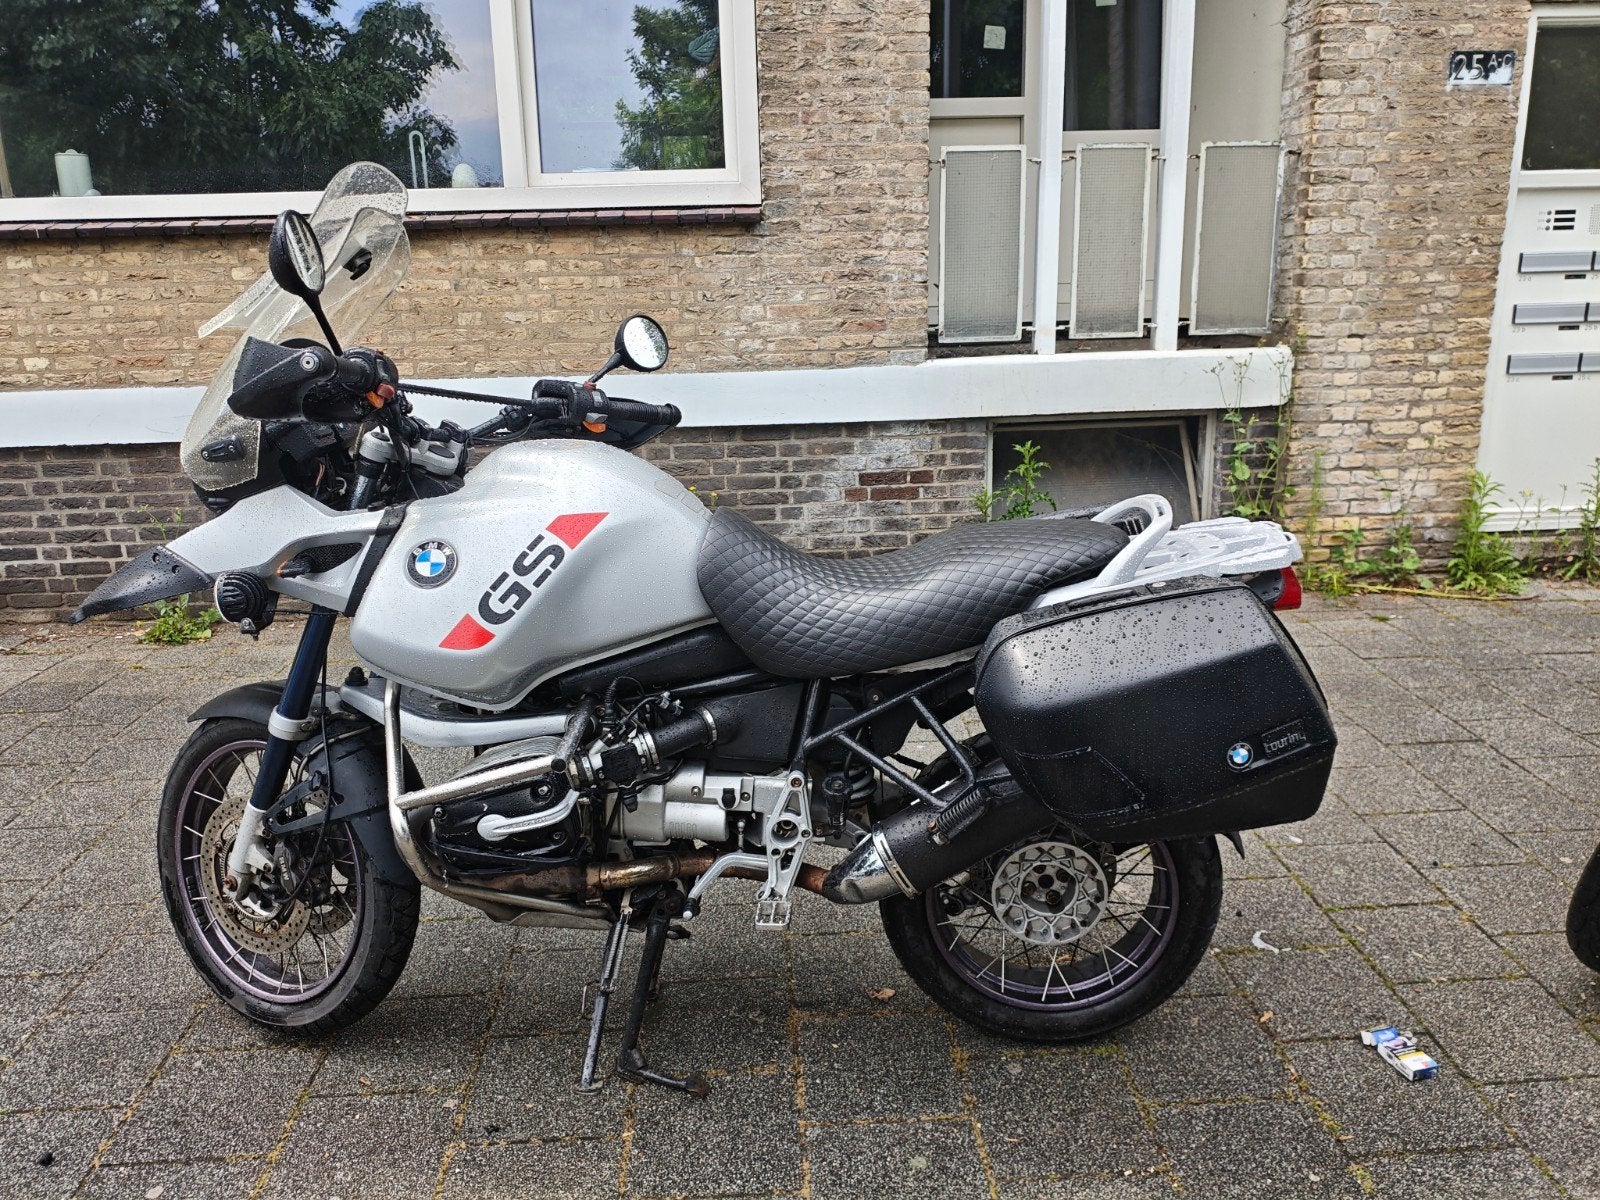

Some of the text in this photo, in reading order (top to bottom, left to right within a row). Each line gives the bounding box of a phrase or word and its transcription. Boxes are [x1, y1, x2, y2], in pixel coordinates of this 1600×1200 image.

[1452, 54, 1484, 80] 25
[413, 541, 452, 556] BMW
[478, 533, 565, 625] GS
